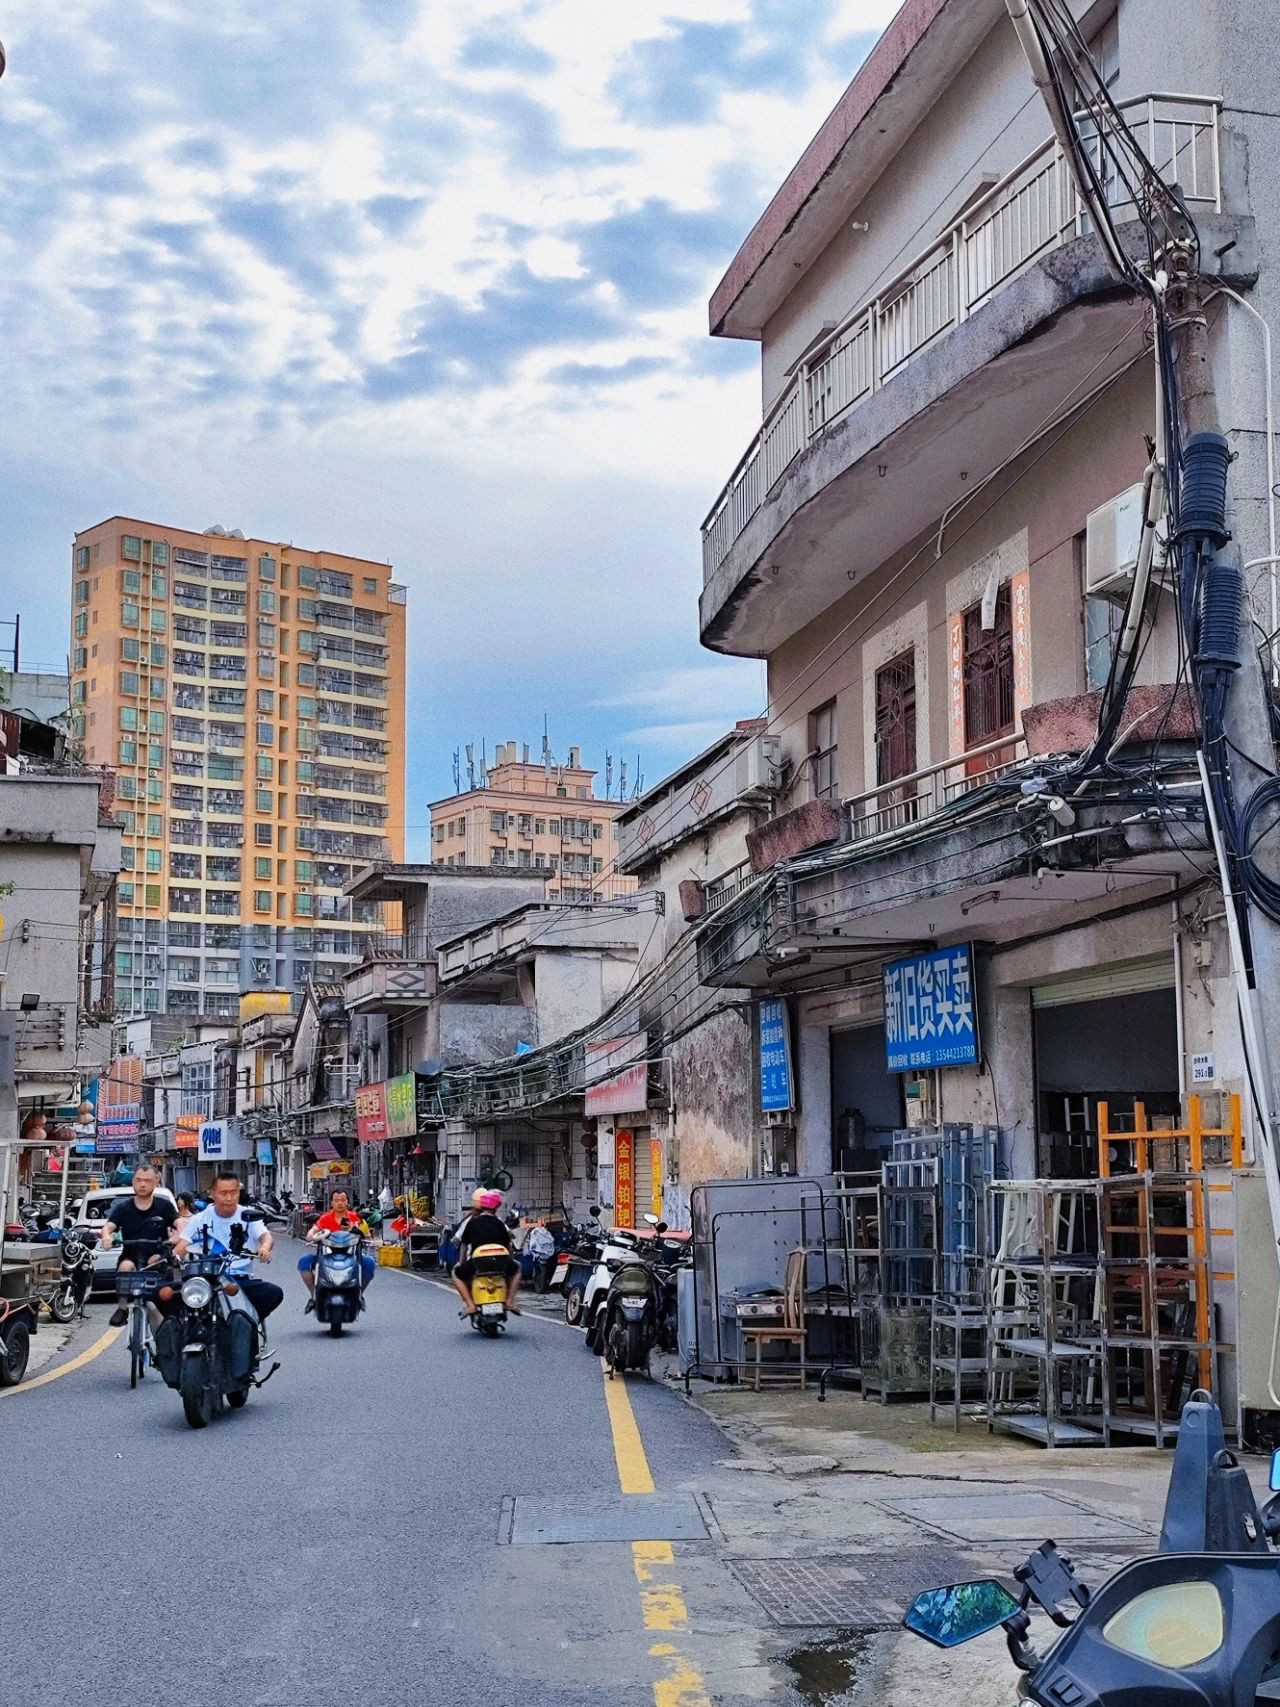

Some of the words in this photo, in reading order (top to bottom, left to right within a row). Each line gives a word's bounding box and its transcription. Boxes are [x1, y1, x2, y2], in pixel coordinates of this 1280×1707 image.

[885, 951, 973, 1043] 新旧货买卖
[618, 1140, 631, 1227] 金银铂钯
